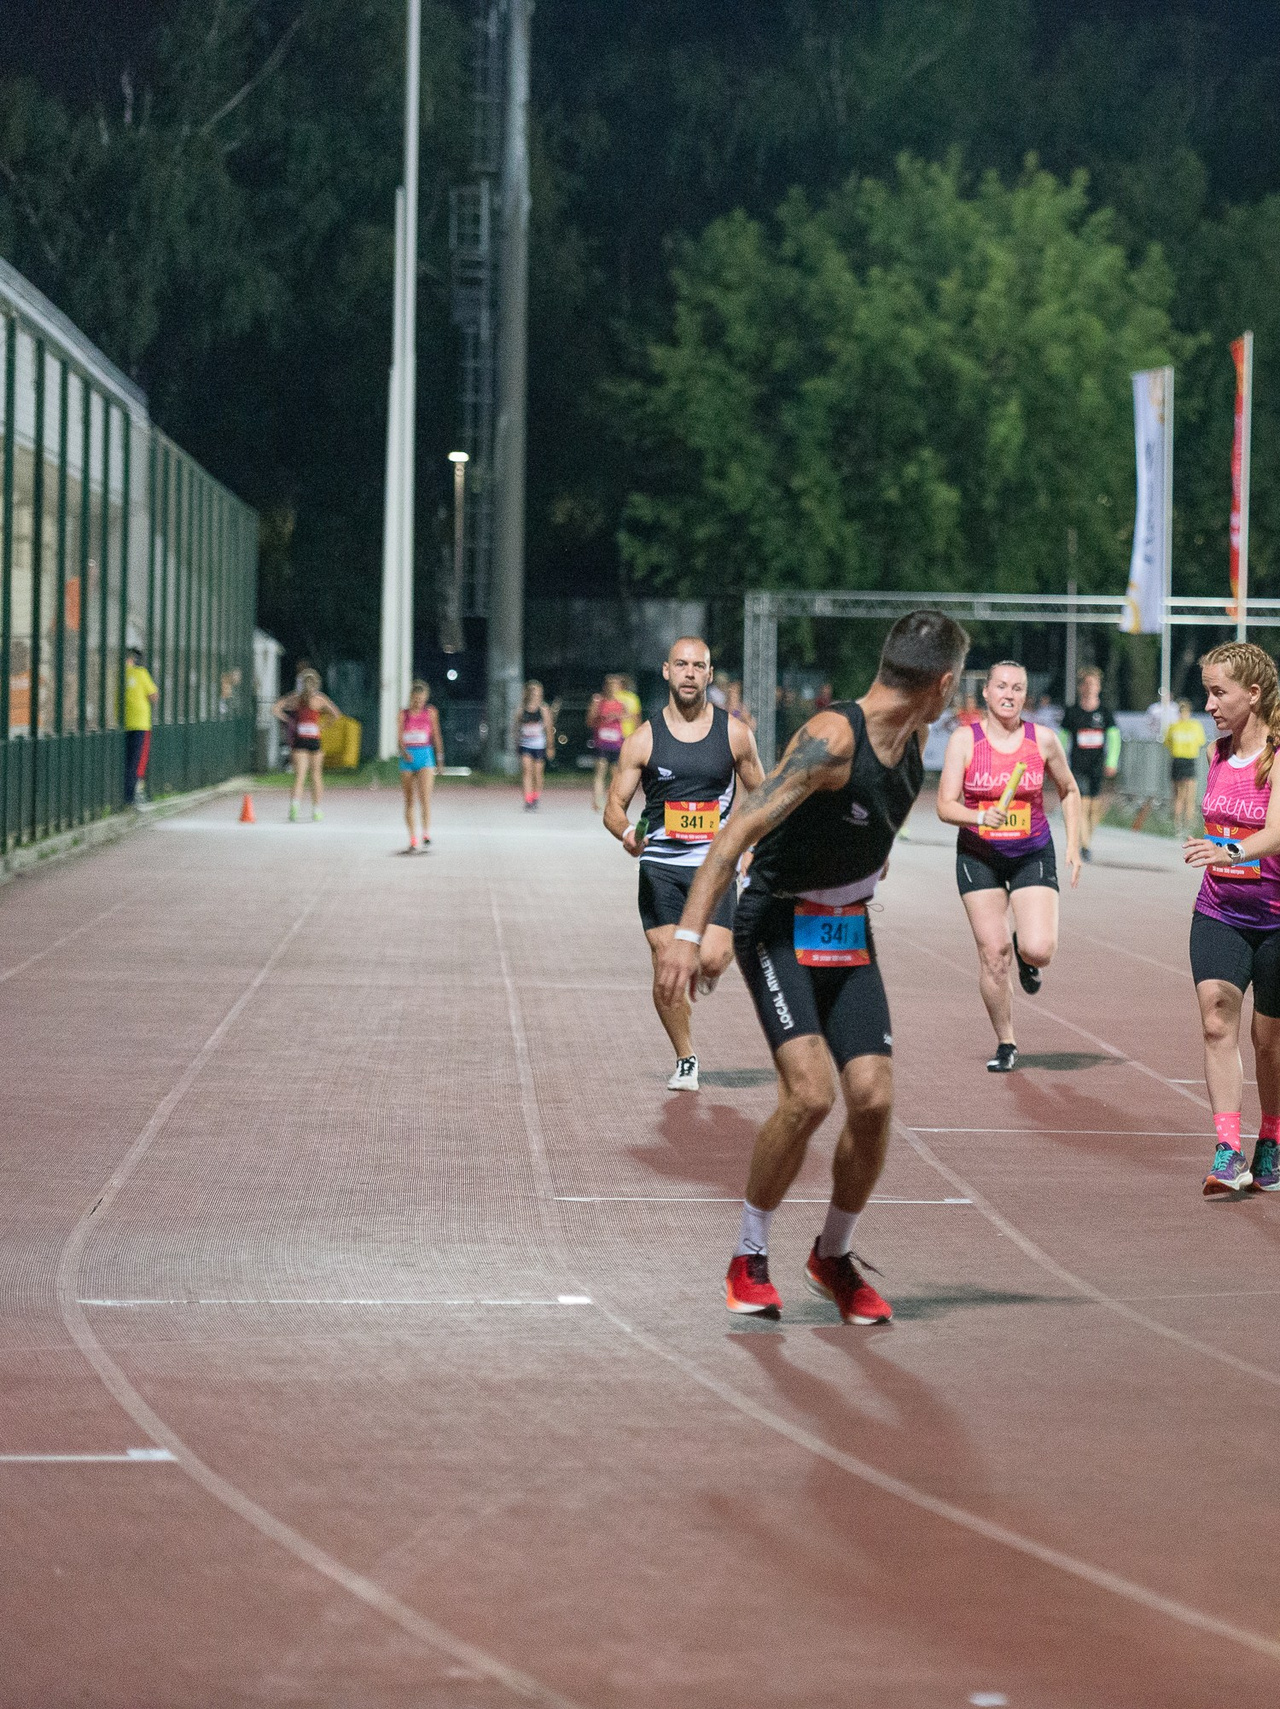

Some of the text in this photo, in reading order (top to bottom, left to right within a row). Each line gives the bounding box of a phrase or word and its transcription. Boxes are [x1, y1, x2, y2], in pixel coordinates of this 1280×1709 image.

[680, 815, 704, 829] 341
[820, 922, 848, 944] 341
[771, 991, 794, 1031] LOCAL
